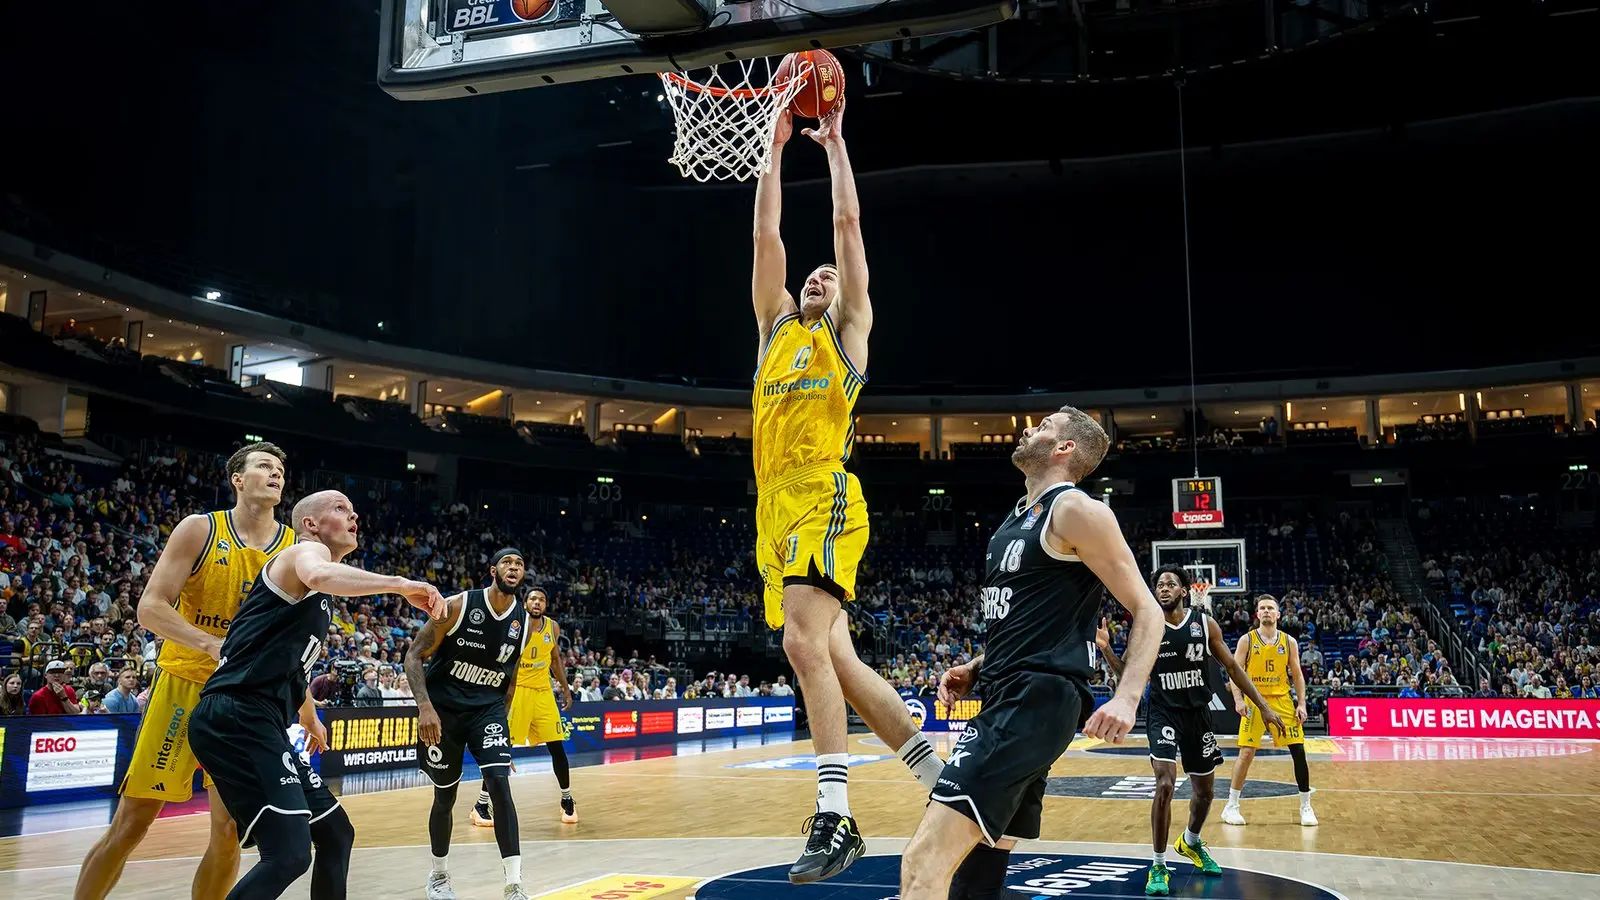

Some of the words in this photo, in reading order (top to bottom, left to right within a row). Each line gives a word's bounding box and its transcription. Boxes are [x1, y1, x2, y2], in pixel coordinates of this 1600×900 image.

[453, 4, 499, 29] BBL
[763, 377, 829, 397] interzero
[793, 392, 827, 401] solutions
[587, 483, 623, 502] 203
[1195, 493, 1210, 509] 12
[920, 495, 953, 512] 202
[1182, 512, 1213, 523] tipico
[999, 538, 1025, 573] 18
[466, 640, 486, 650] VEOLIA
[1185, 643, 1204, 662] 42
[449, 660, 506, 688] TOWERS
[1265, 660, 1274, 673] 15
[1391, 708, 1436, 728] LIVE
[1442, 709, 1475, 728] BEI
[1481, 709, 1592, 729] MAGENTA
[151, 707, 185, 770] interzero
[345, 718, 381, 750] JAHRE
[381, 717, 410, 747] ALBA
[1288, 727, 1300, 738] 15
[35, 737, 77, 753] ERGO
[343, 753, 366, 767] WIR
